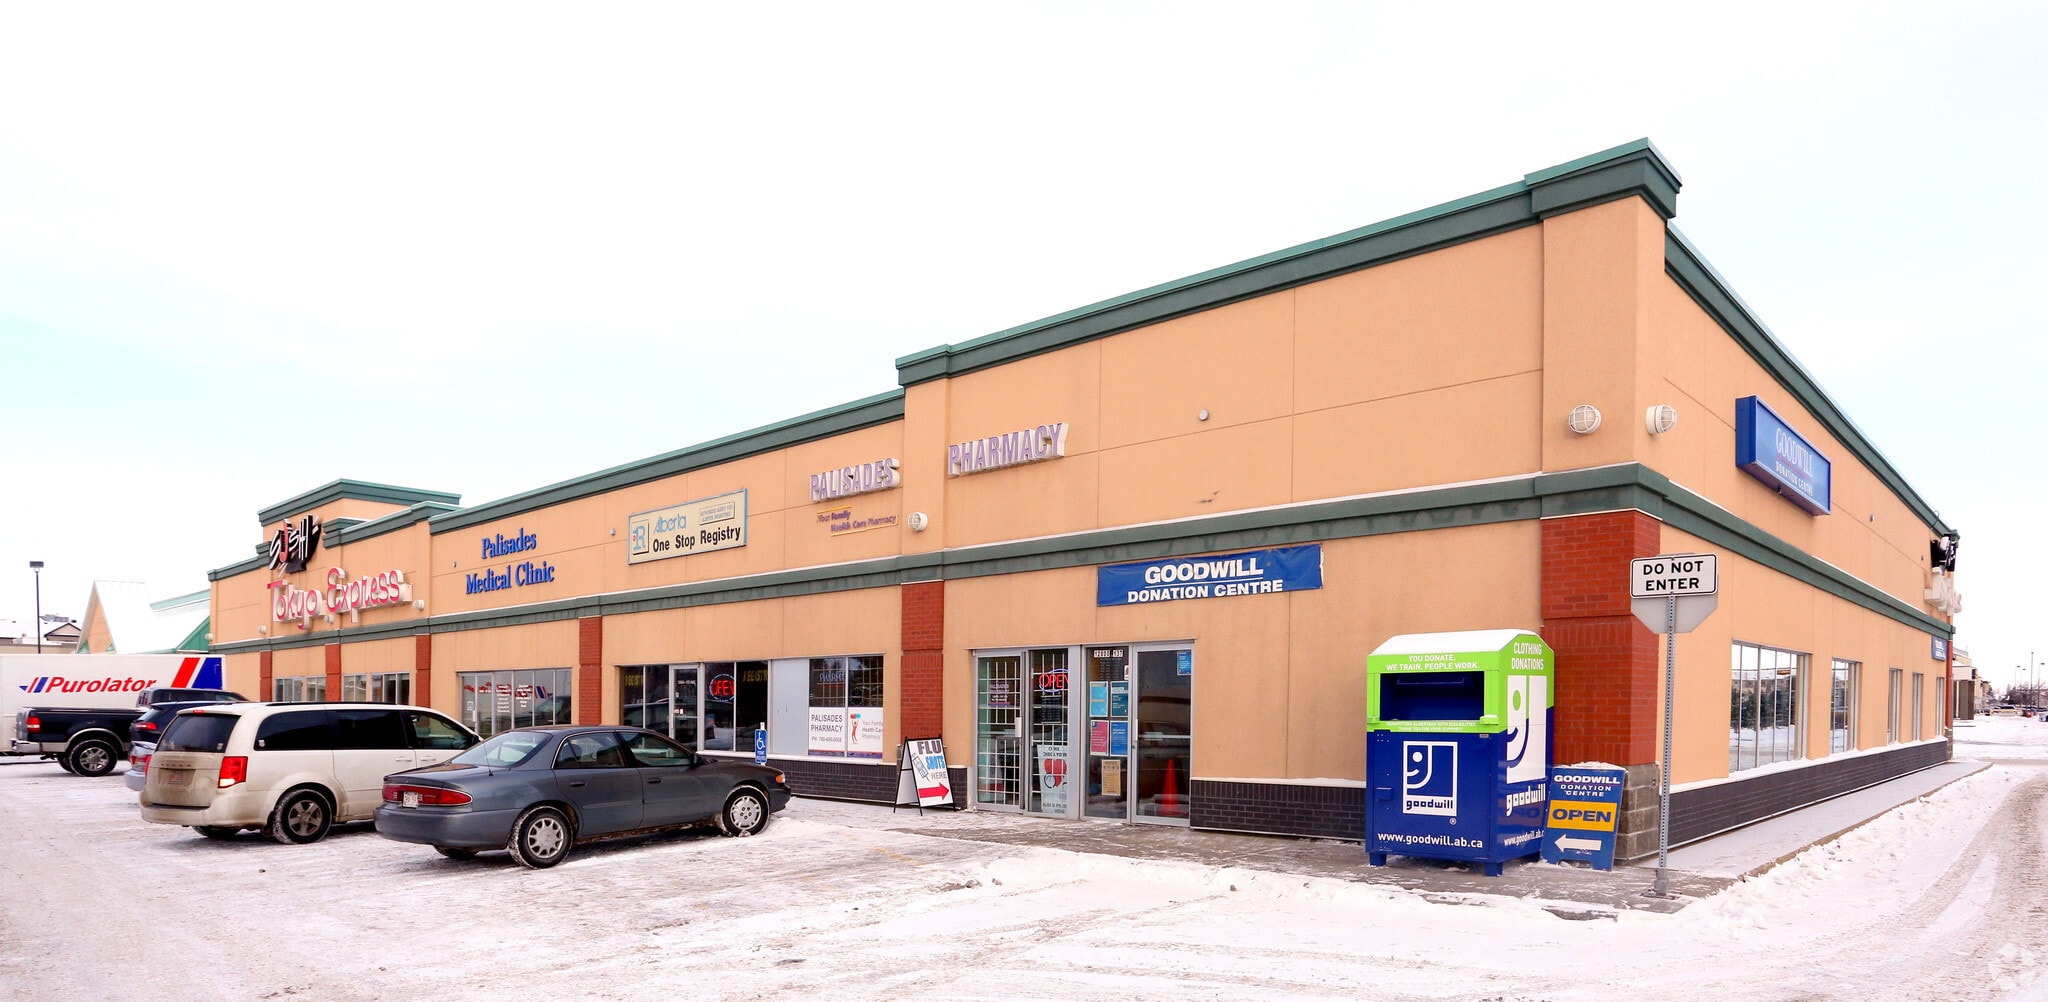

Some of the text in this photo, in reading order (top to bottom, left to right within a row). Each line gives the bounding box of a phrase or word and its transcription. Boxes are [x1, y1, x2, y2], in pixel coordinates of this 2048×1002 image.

[948, 422, 1069, 476] PHARMACY
[1775, 427, 1813, 478] GOODWILL
[810, 457, 900, 503] PALISADES
[1775, 461, 1813, 497] DONATION CENTRE
[831, 509, 851, 520] Family
[830, 515, 897, 532] Health Care Pharmacy
[481, 527, 537, 560] Palisades
[653, 526, 741, 553] One Stop Registry
[1144, 557, 1264, 584] GOODWILL
[1643, 561, 1704, 576] DO NOT
[465, 560, 555, 594] Medical Clinic
[1645, 577, 1700, 592] ENTER
[267, 567, 403, 630] Tokyo Express
[1127, 579, 1284, 603] DONATION CENTRE
[1513, 642, 1543, 655] CLOTHING
[1424, 654, 1456, 662] DONATE.
[1511, 657, 1544, 670] DONATIONS
[1386, 663, 1398, 671] WE
[1424, 662, 1453, 670] PEOPLE
[1454, 661, 1480, 669] WORK.
[45, 677, 156, 693] Purolator
[811, 714, 843, 723] PALISADES
[917, 740, 942, 754] FLU
[925, 755, 946, 770] SHOTS
[930, 771, 947, 780] HERE
[1554, 775, 1620, 784] GOODWILL
[1406, 799, 1453, 810] goodwill
[1506, 783, 1546, 817] goodwill
[1552, 808, 1612, 823] OPEN
[1377, 833, 1483, 848] www.goodwill.ab.ca
[1504, 829, 1544, 846] www.goodwill.ab.c
